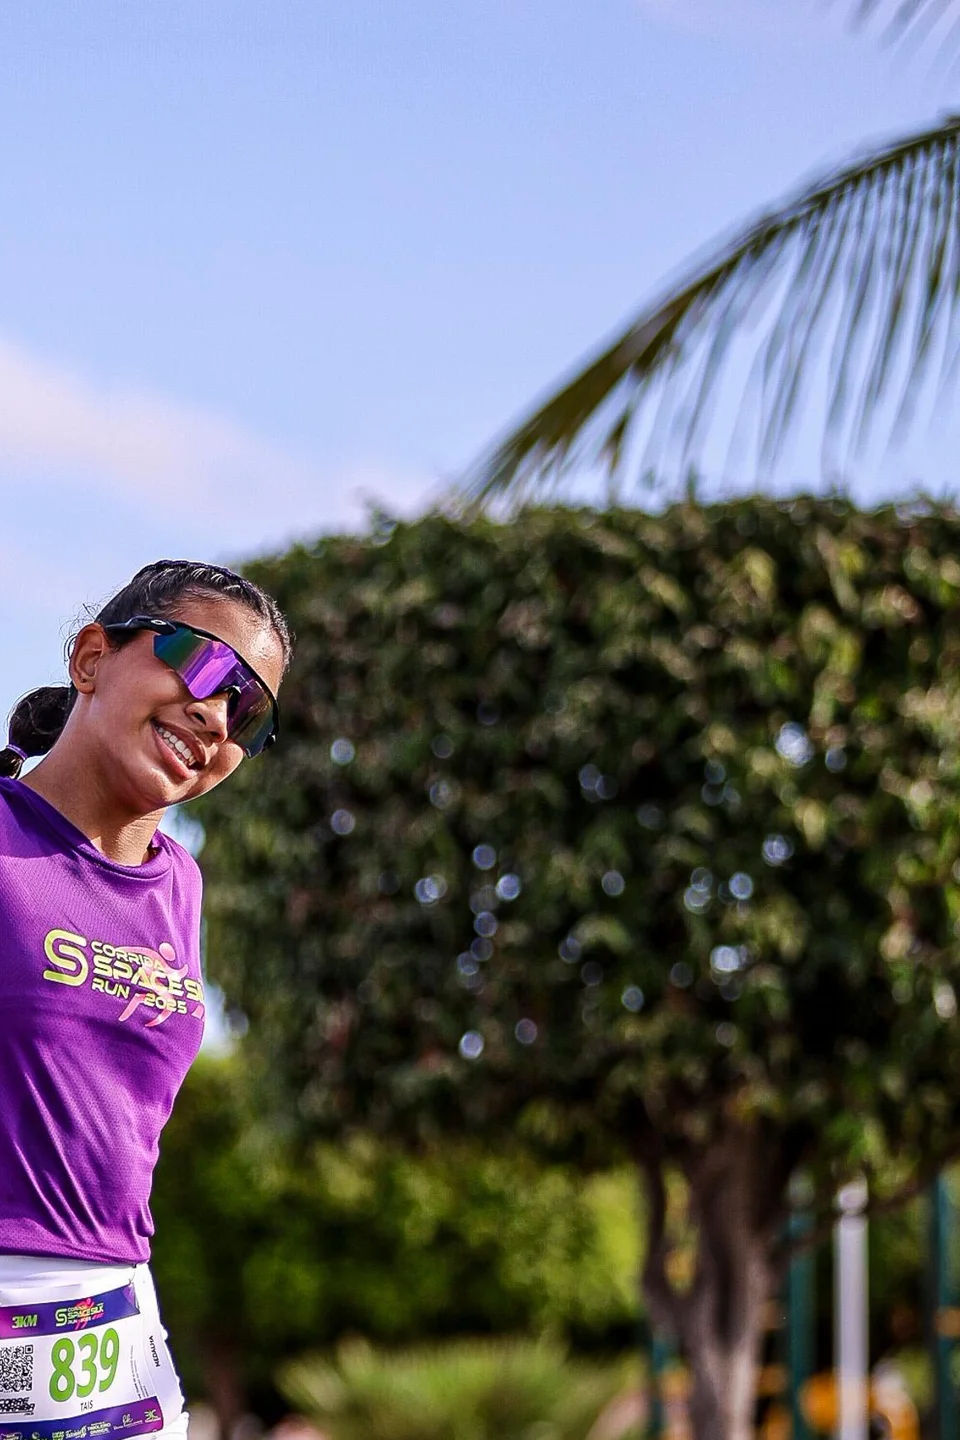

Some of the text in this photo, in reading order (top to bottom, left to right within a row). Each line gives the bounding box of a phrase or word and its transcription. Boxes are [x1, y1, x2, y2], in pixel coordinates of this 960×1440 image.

[91, 940, 166, 972] CORRIDA
[91, 977, 188, 1015] RUN 2025
[11, 1314, 38, 1329] 3KM
[49, 1327, 120, 1402] 839
[148, 1335, 161, 1368] MEDALHA
[80, 1400, 94, 1411] TAIS
